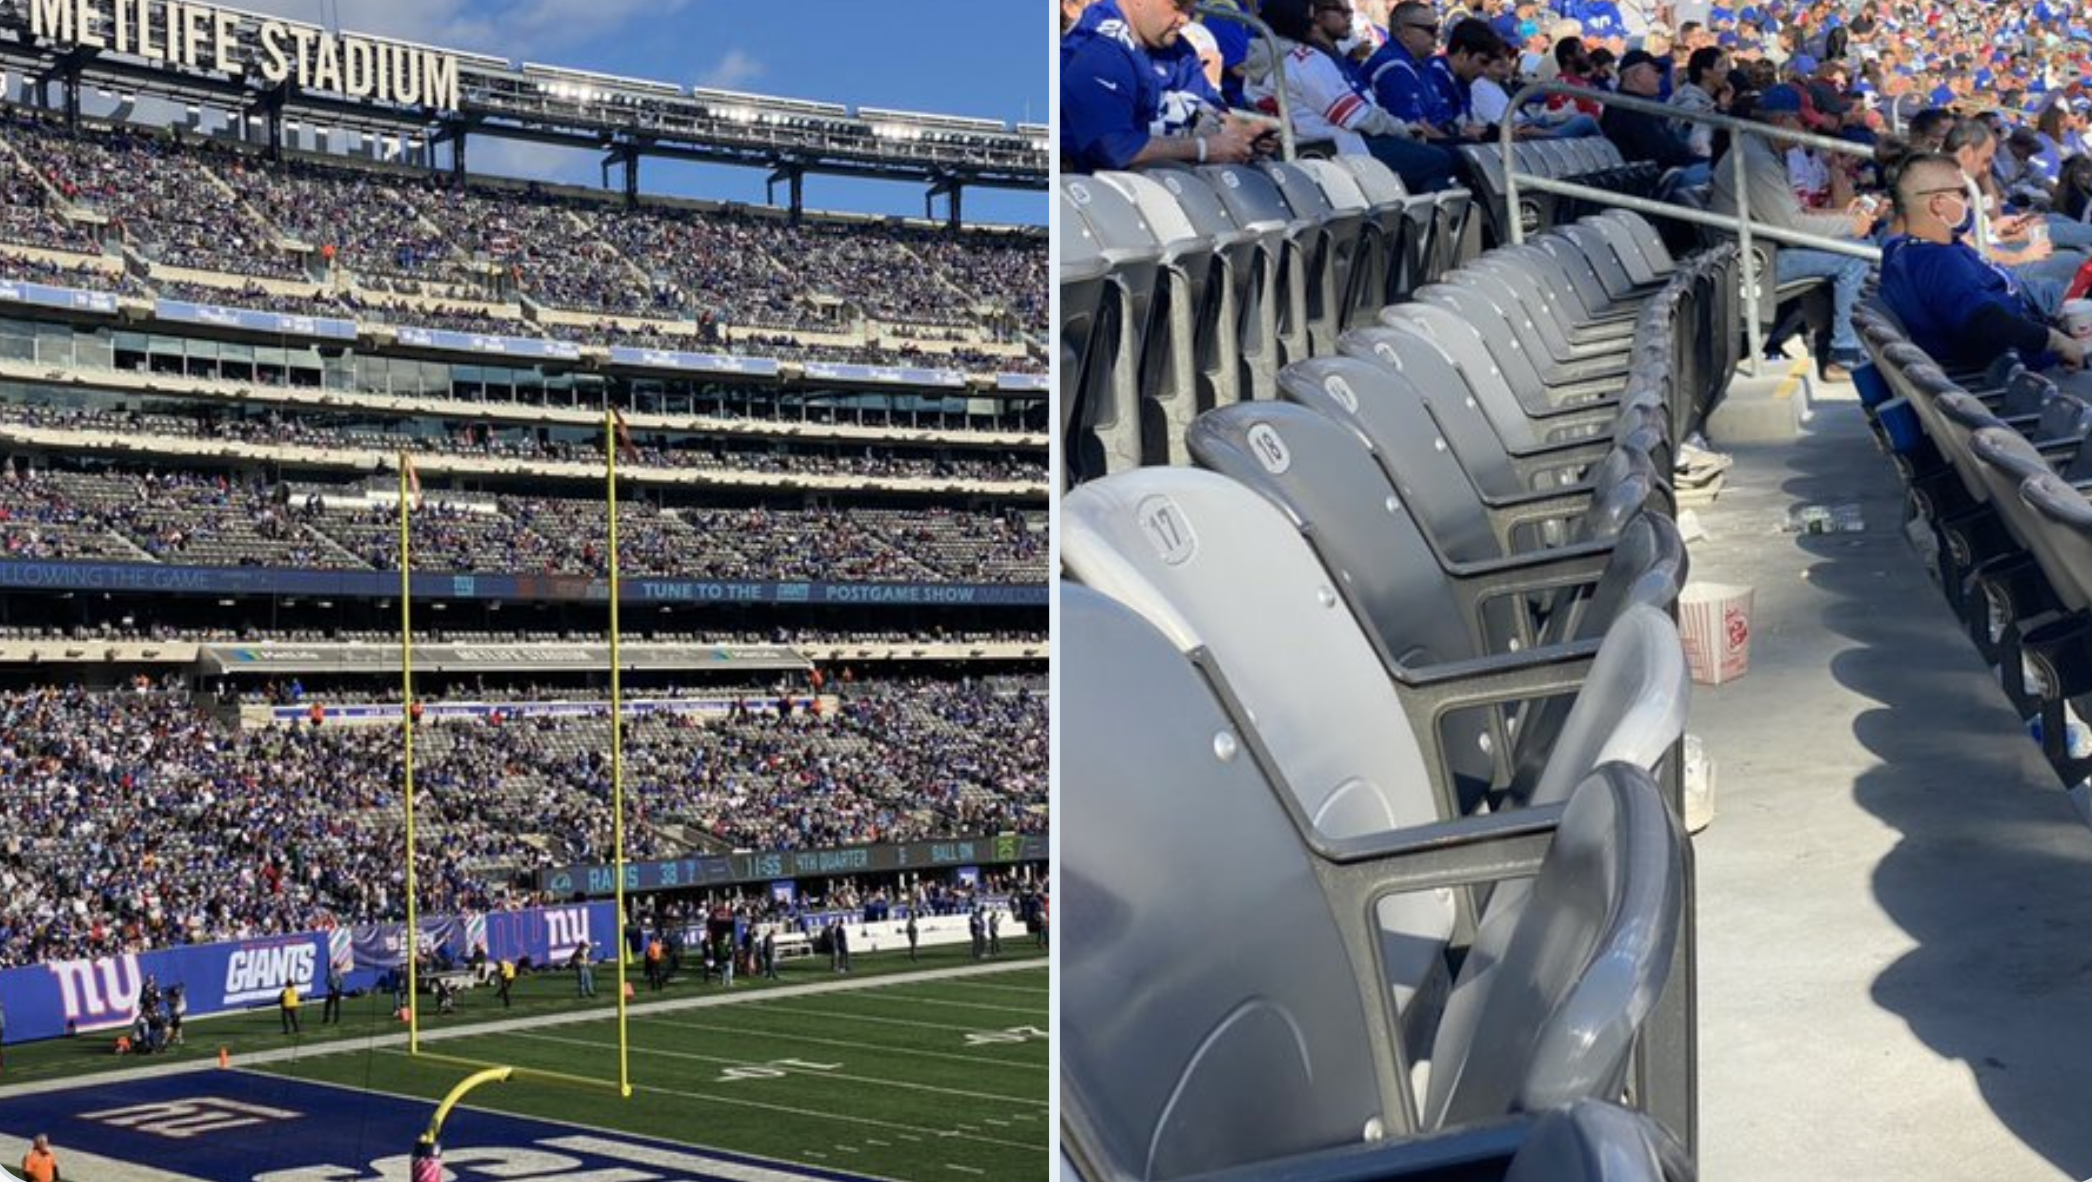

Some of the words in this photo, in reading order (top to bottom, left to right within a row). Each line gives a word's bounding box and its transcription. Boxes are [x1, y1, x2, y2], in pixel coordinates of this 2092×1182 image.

[30, 0, 244, 74] METLIFE
[260, 21, 459, 112] STADIUM
[1149, 506, 1182, 551] 17
[109, 566, 147, 587] THE
[152, 567, 209, 588] GAME
[643, 583, 693, 599] TUNE
[697, 583, 724, 599] TO
[727, 584, 762, 599] THE
[826, 585, 919, 601] POSTGAME
[924, 587, 976, 602] SHOW
[819, 849, 868, 871] QUARTER
[660, 861, 678, 886] 38
[226, 941, 317, 993] GIANTS
